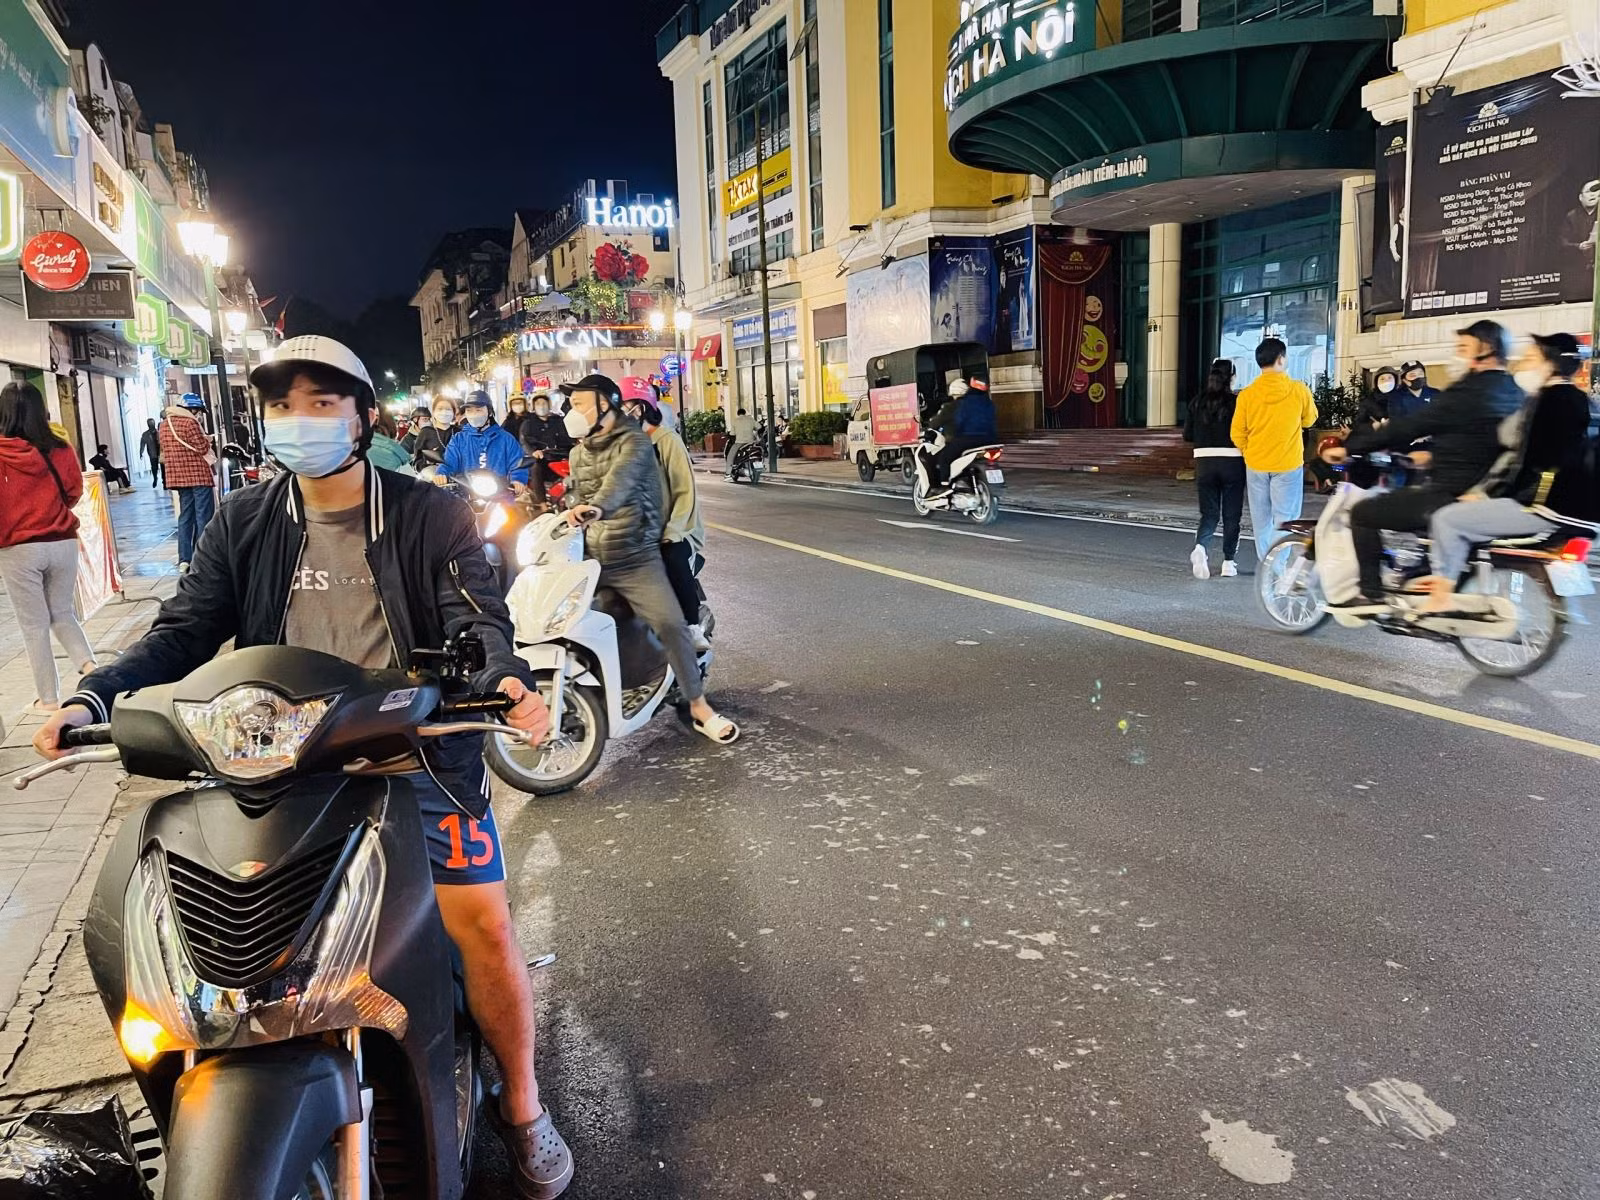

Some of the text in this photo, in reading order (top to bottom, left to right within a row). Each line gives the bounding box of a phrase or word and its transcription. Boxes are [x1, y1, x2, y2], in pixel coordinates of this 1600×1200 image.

[585, 197, 675, 228] Hanoi
[30, 249, 77, 273] Givral
[438, 814, 495, 869] 15
